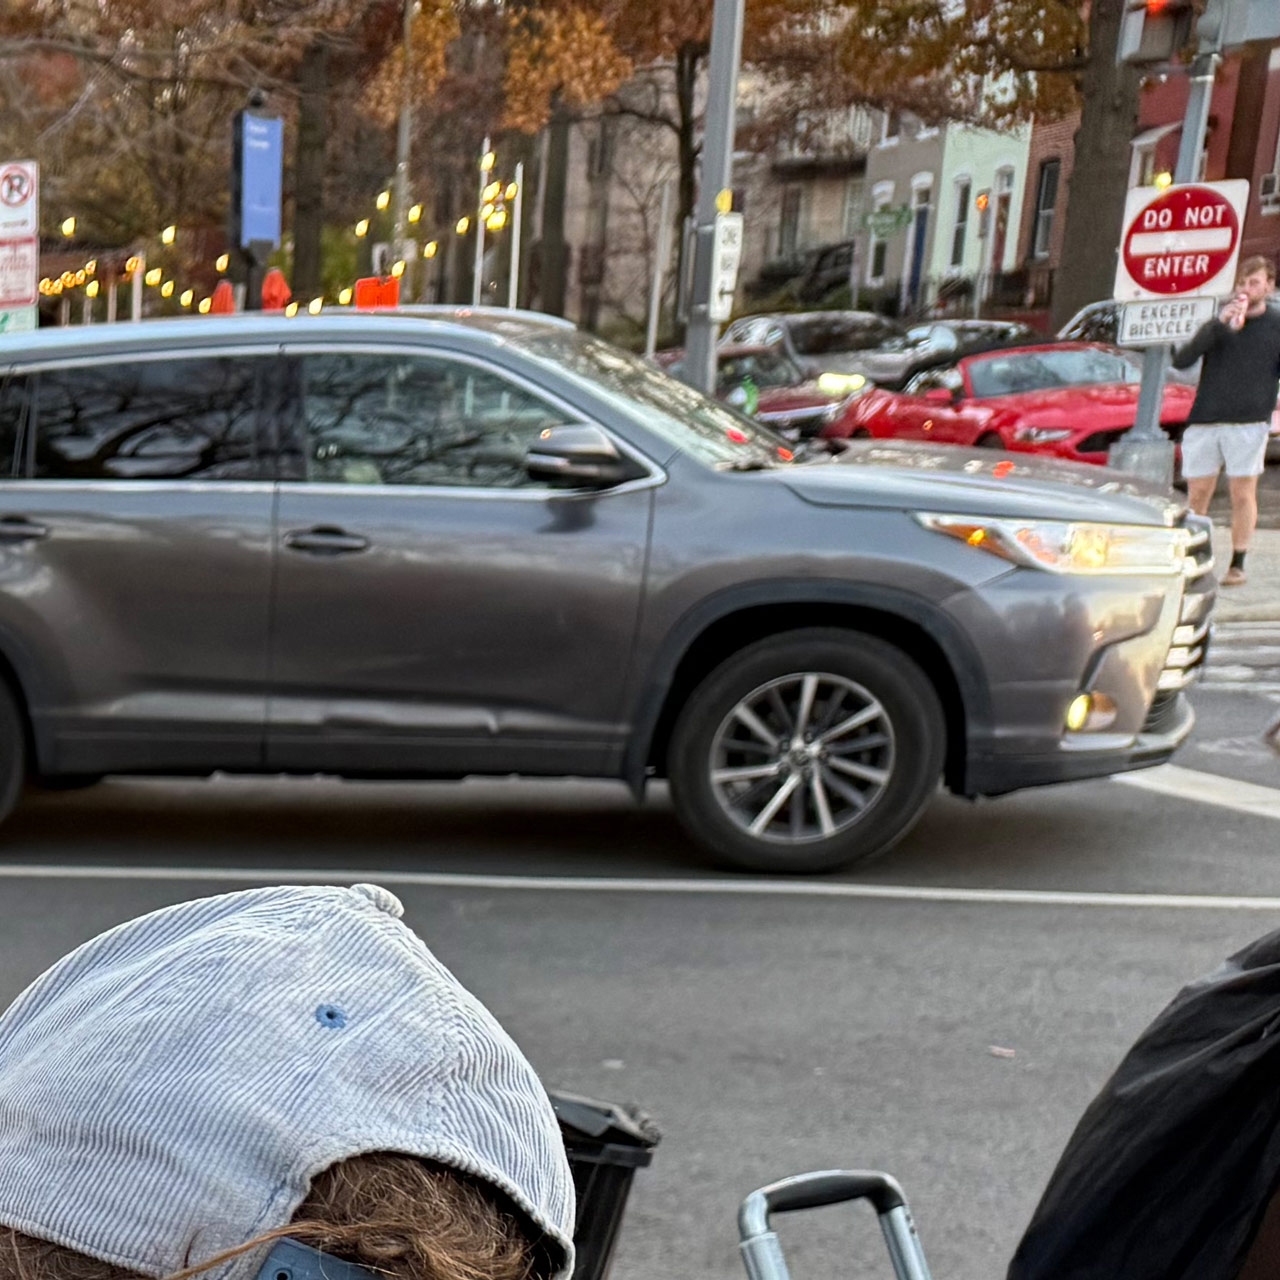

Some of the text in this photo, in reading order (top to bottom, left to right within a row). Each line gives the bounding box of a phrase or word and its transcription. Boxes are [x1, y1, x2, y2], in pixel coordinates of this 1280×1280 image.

[1144, 205, 1225, 229] DO NOT
[1144, 254, 1209, 277] ENTER
[1141, 303, 1197, 319] EXCEPT
